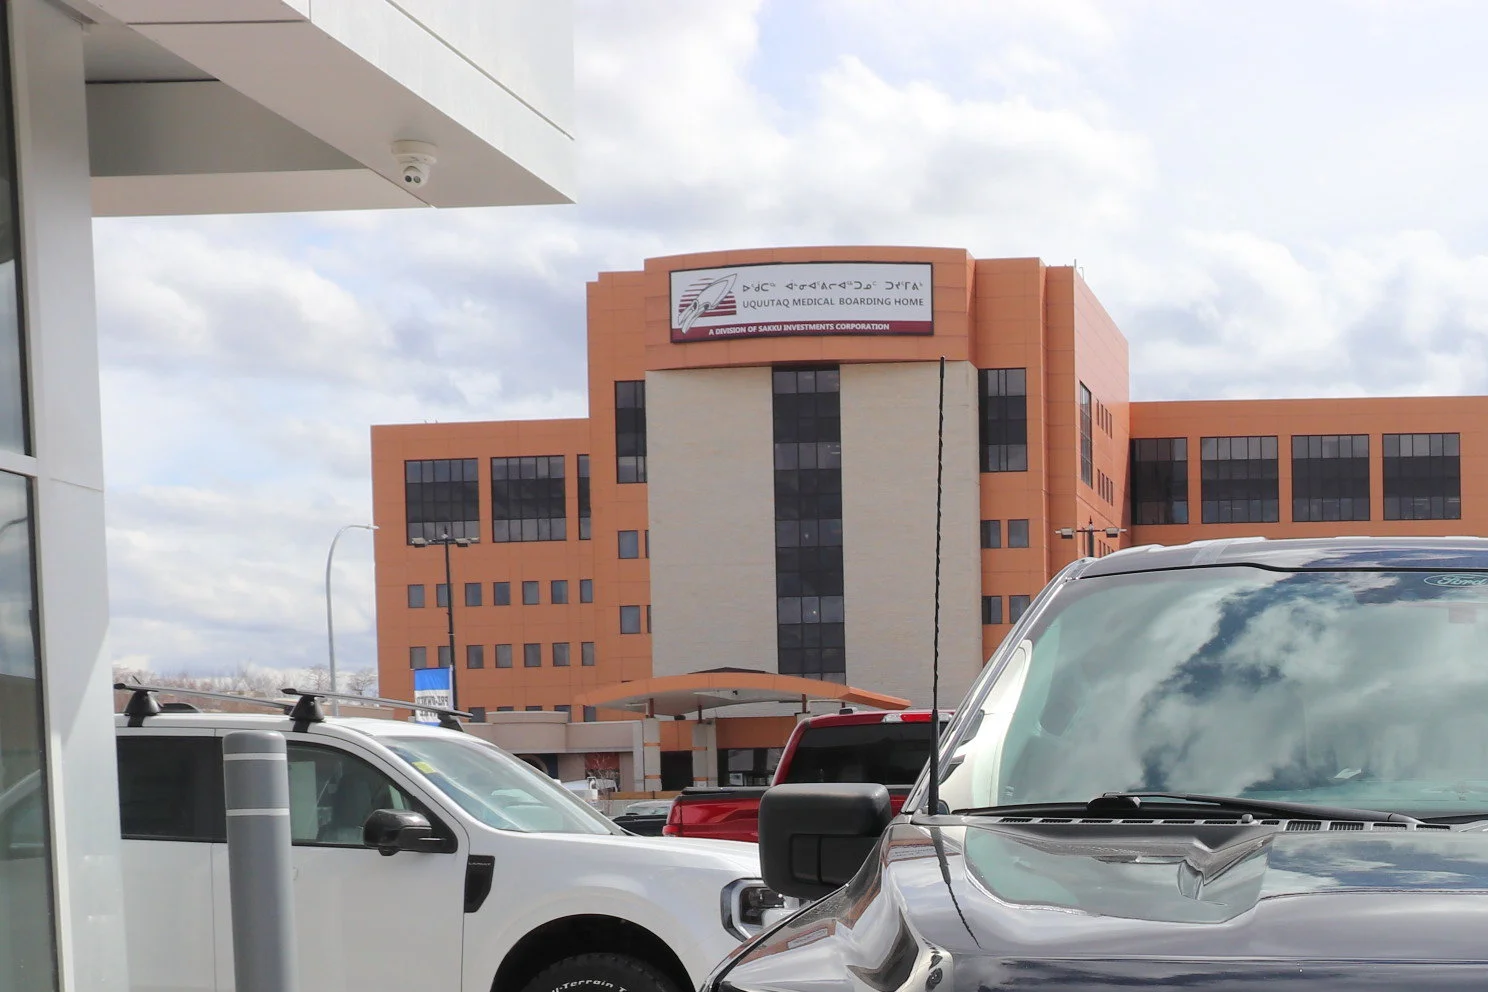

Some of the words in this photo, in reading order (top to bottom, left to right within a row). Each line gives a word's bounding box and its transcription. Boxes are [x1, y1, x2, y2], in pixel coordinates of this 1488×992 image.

[743, 299, 790, 309] UQUUTAQ
[792, 298, 834, 306] MEDICAL
[839, 298, 891, 306] BOARDING
[716, 327, 746, 335] DIVISION
[783, 323, 834, 331] INVESTMENTS
[835, 322, 890, 330] CORPORATION
[1437, 574, 1487, 585] Ford
